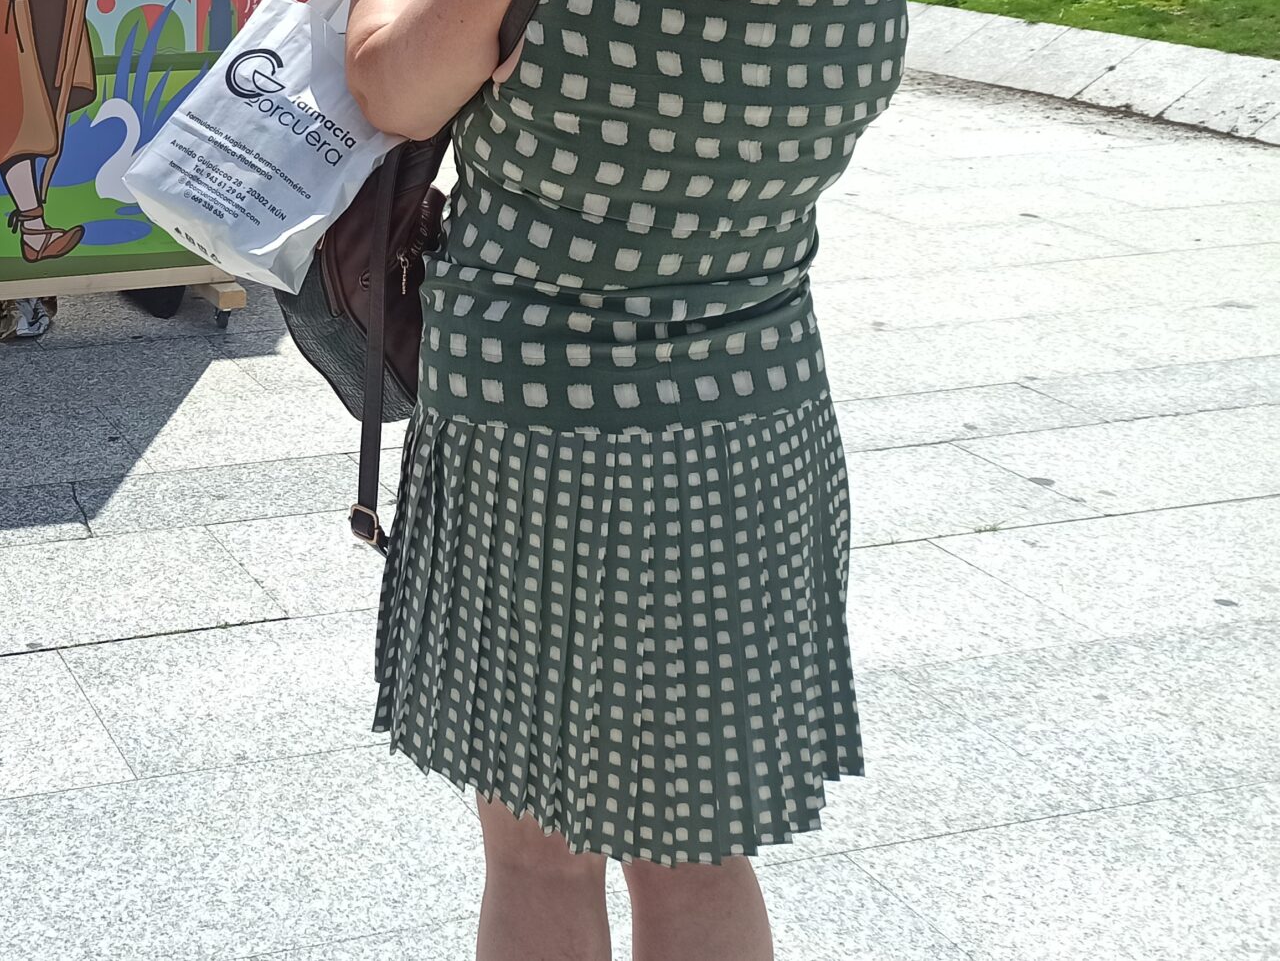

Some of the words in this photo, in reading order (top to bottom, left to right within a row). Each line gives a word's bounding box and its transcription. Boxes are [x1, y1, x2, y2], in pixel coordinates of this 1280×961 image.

[170, 139, 197, 159] Avenida
[197, 155, 233, 182] Guipúzcoa
[232, 177, 244, 188] 28
[247, 187, 270, 208] 20302
[267, 203, 287, 222] IRÚN
[205, 172, 218, 185] 943
[225, 184, 238, 195] 29
[235, 191, 247, 202] 04
[190, 194, 203, 205] 669
